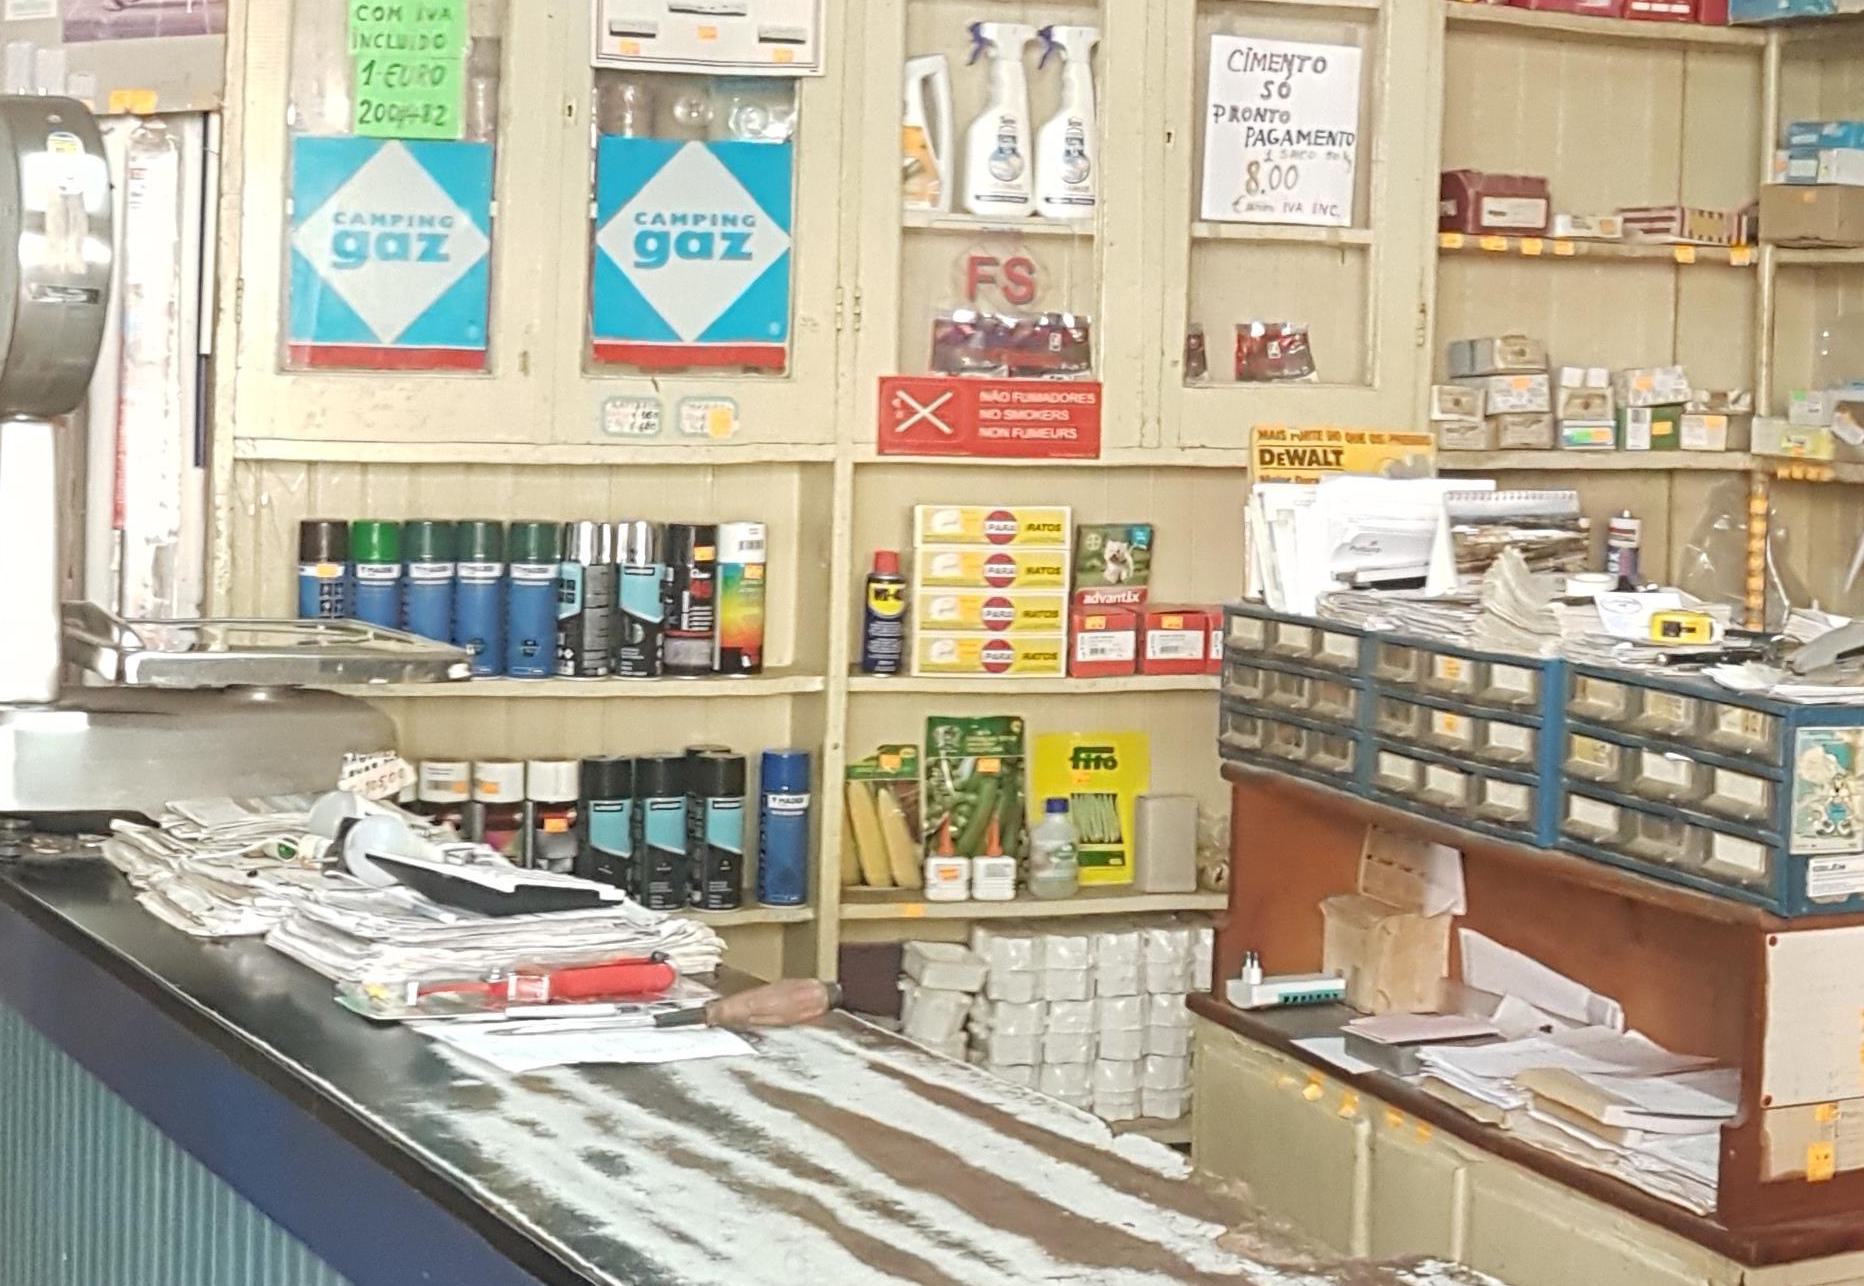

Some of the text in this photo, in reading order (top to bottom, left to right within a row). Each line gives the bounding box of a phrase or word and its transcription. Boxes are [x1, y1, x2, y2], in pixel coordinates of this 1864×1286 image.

[355, 4, 403, 22] COM
[1226, 47, 1328, 79] CIMENTO
[1211, 103, 1291, 125] PRONTO
[1244, 126, 1356, 149] PAGAMENTO
[332, 210, 455, 229] CAMPING
[633, 210, 756, 229] CAMPING
[330, 228, 450, 269] gaz
[632, 227, 754, 269] gaz
[965, 254, 1036, 306] FS
[1082, 590, 1140, 605] advantix
